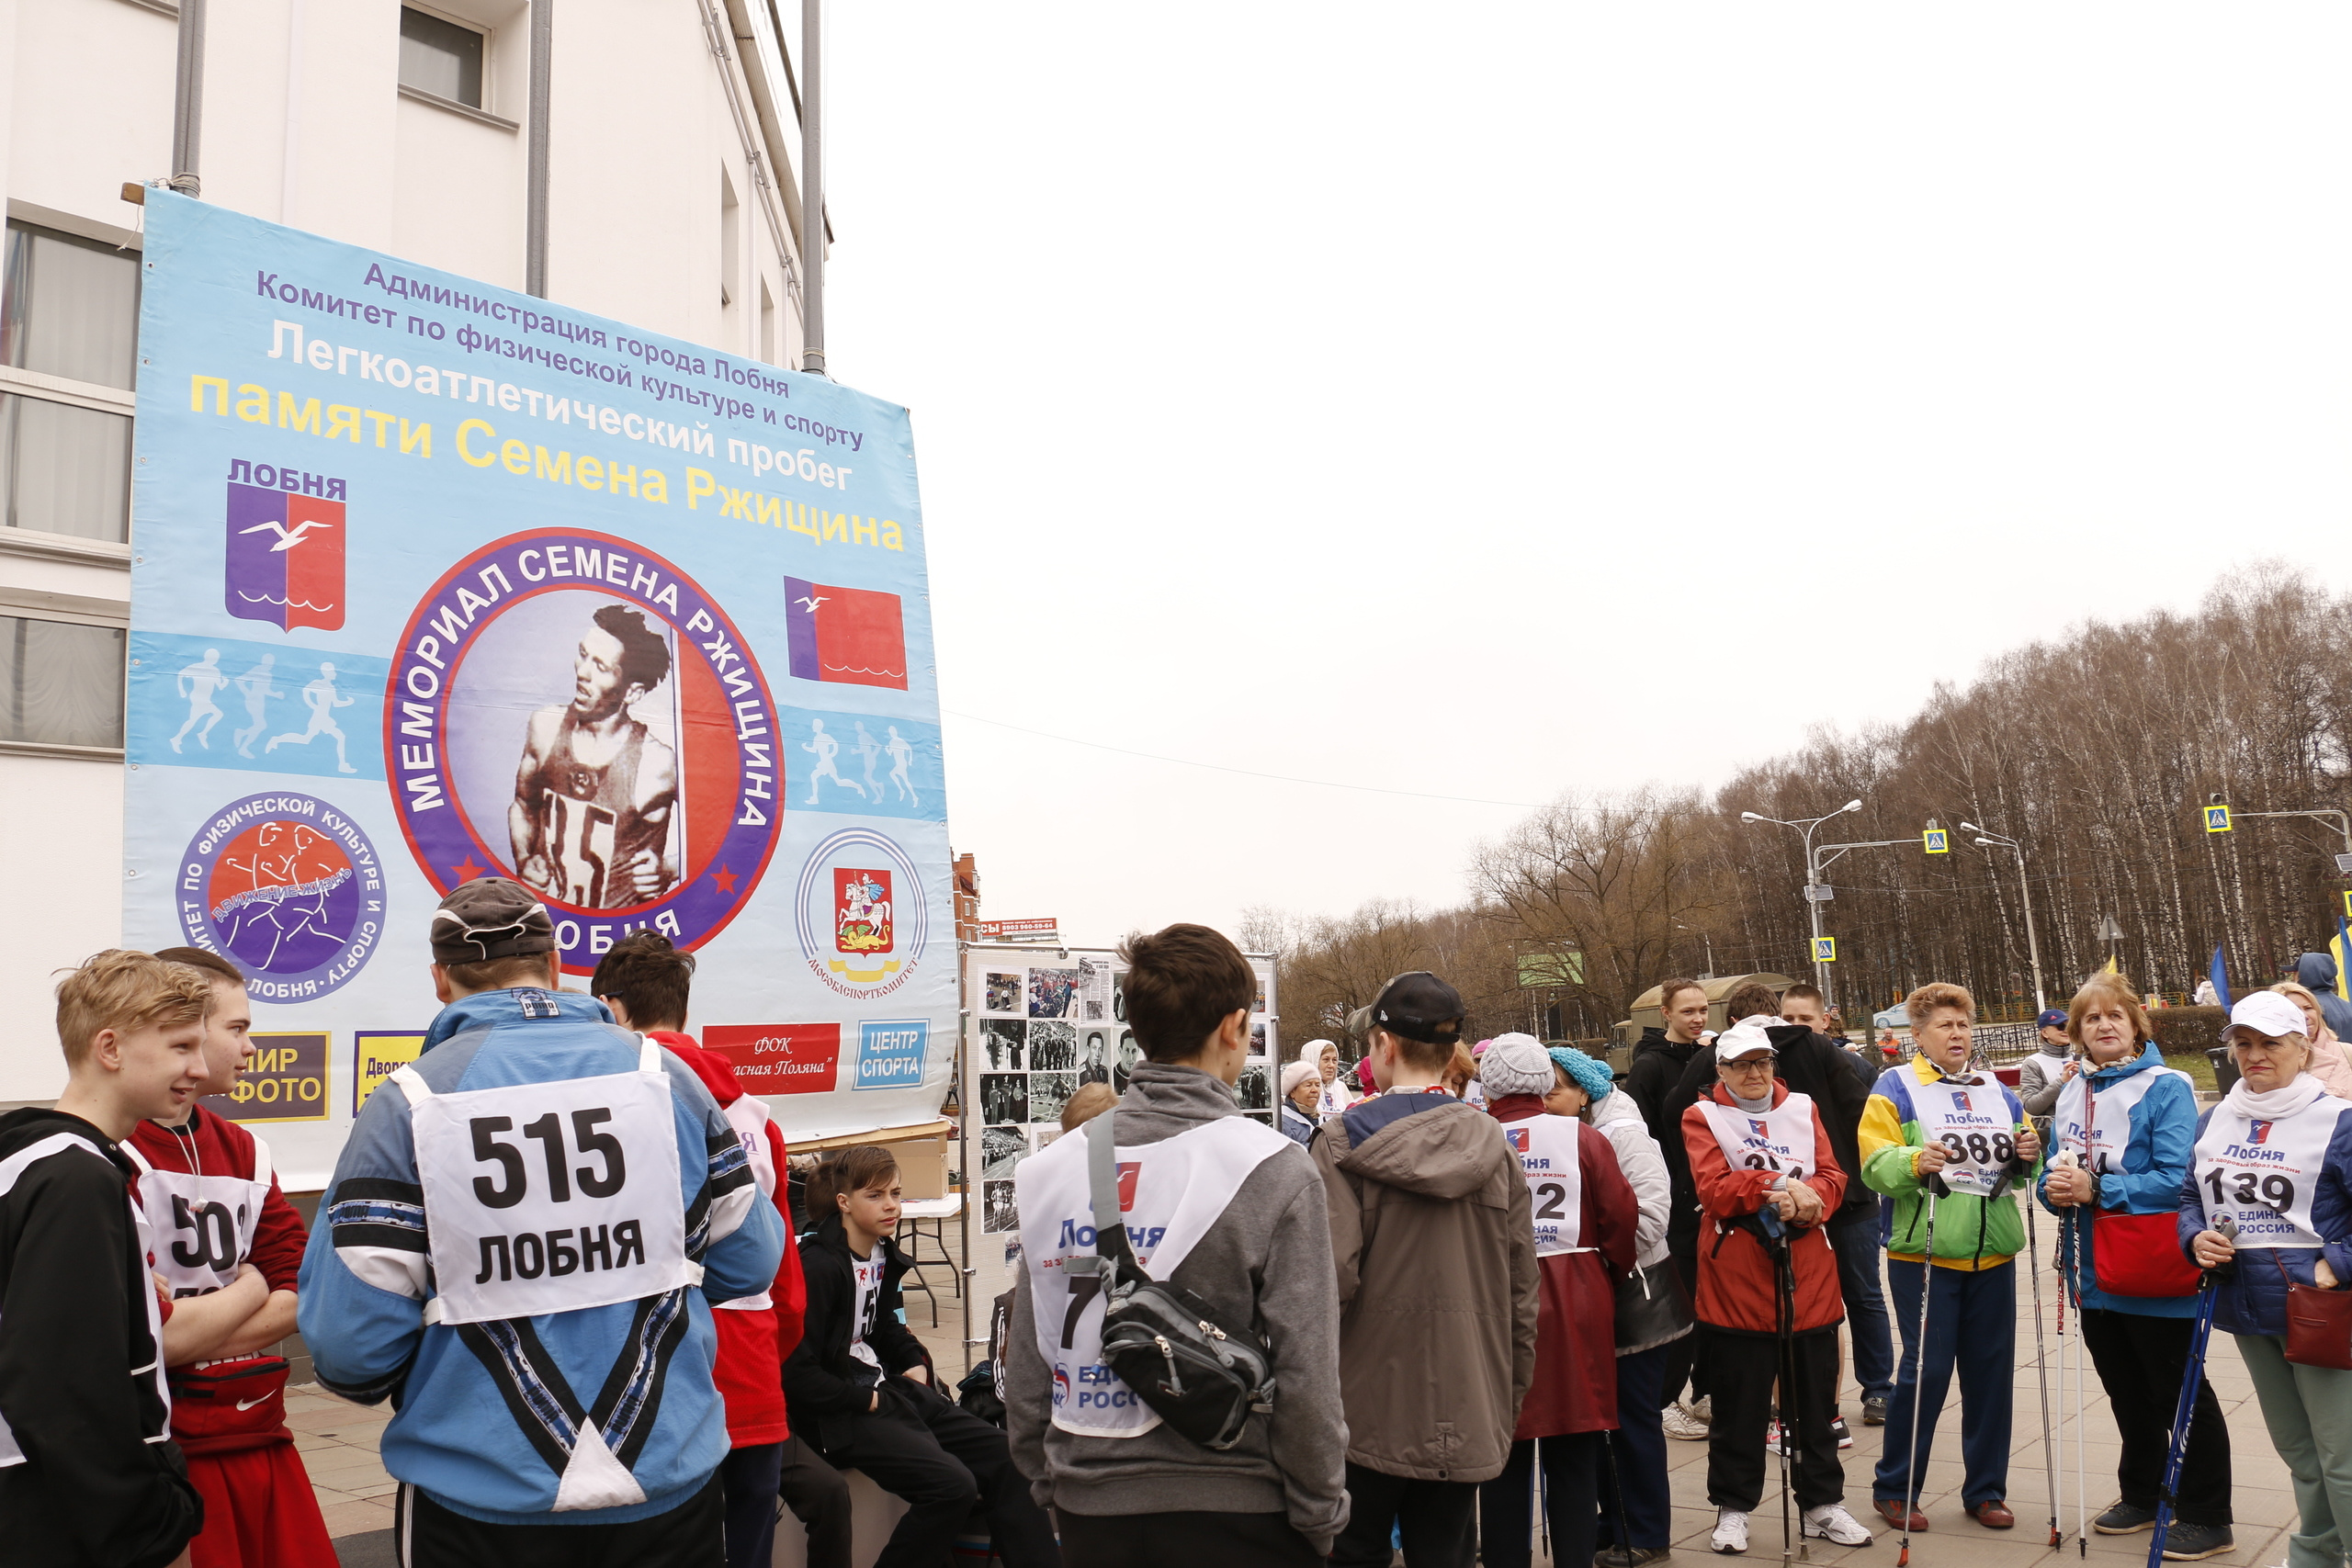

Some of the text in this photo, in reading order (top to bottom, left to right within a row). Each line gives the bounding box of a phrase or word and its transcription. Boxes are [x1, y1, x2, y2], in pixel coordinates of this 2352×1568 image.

[364, 263, 790, 399] Администрация города Лобня
[257, 270, 864, 452] Комитет по физической культуре и спорту
[267, 319, 853, 491] Легкоатлетический пробег
[190, 374, 904, 551] памяти Семена Ржищина
[227, 458, 346, 502] ЛОБНЯ
[401, 545, 773, 827] МЕМОРИАЛ СЕМЕНА РЖИЩИНА
[184, 797, 381, 986] ИТЕТ ПО ФИЗИЧЕСКОЙ КУЛЬТУРЕ И СПОРТУ
[554, 908, 682, 954] ОБЯ
[247, 978, 317, 998] ЛОБНЯ
[754, 1037, 793, 1055] ФОК
[870, 1031, 919, 1055] ЦЕНТР
[366, 1057, 411, 1078] Двор
[732, 1064, 772, 1077] асная
[861, 1057, 919, 1077] СПОРТА
[230, 1077, 322, 1104] ФОТО
[1944, 1112, 1994, 1123] Лобня
[469, 1107, 627, 1209] 515
[1940, 1133, 2014, 1165] 388
[2222, 1144, 2286, 1162] Лобня
[2271, 1164, 2301, 1175] жизни
[2204, 1168, 2295, 1213] 139
[1532, 1224, 1558, 1235] НАЯ
[2238, 1210, 2285, 1222] ЕДИНА
[2238, 1224, 2295, 1234] РОССИЯ
[1058, 1218, 1167, 1248] Лоня
[1533, 1235, 1557, 1245] СИЯ
[475, 1219, 645, 1284] ЛОБНЯ
[1060, 1276, 1102, 1349] 7
[1079, 1391, 1139, 1409] РОСС
